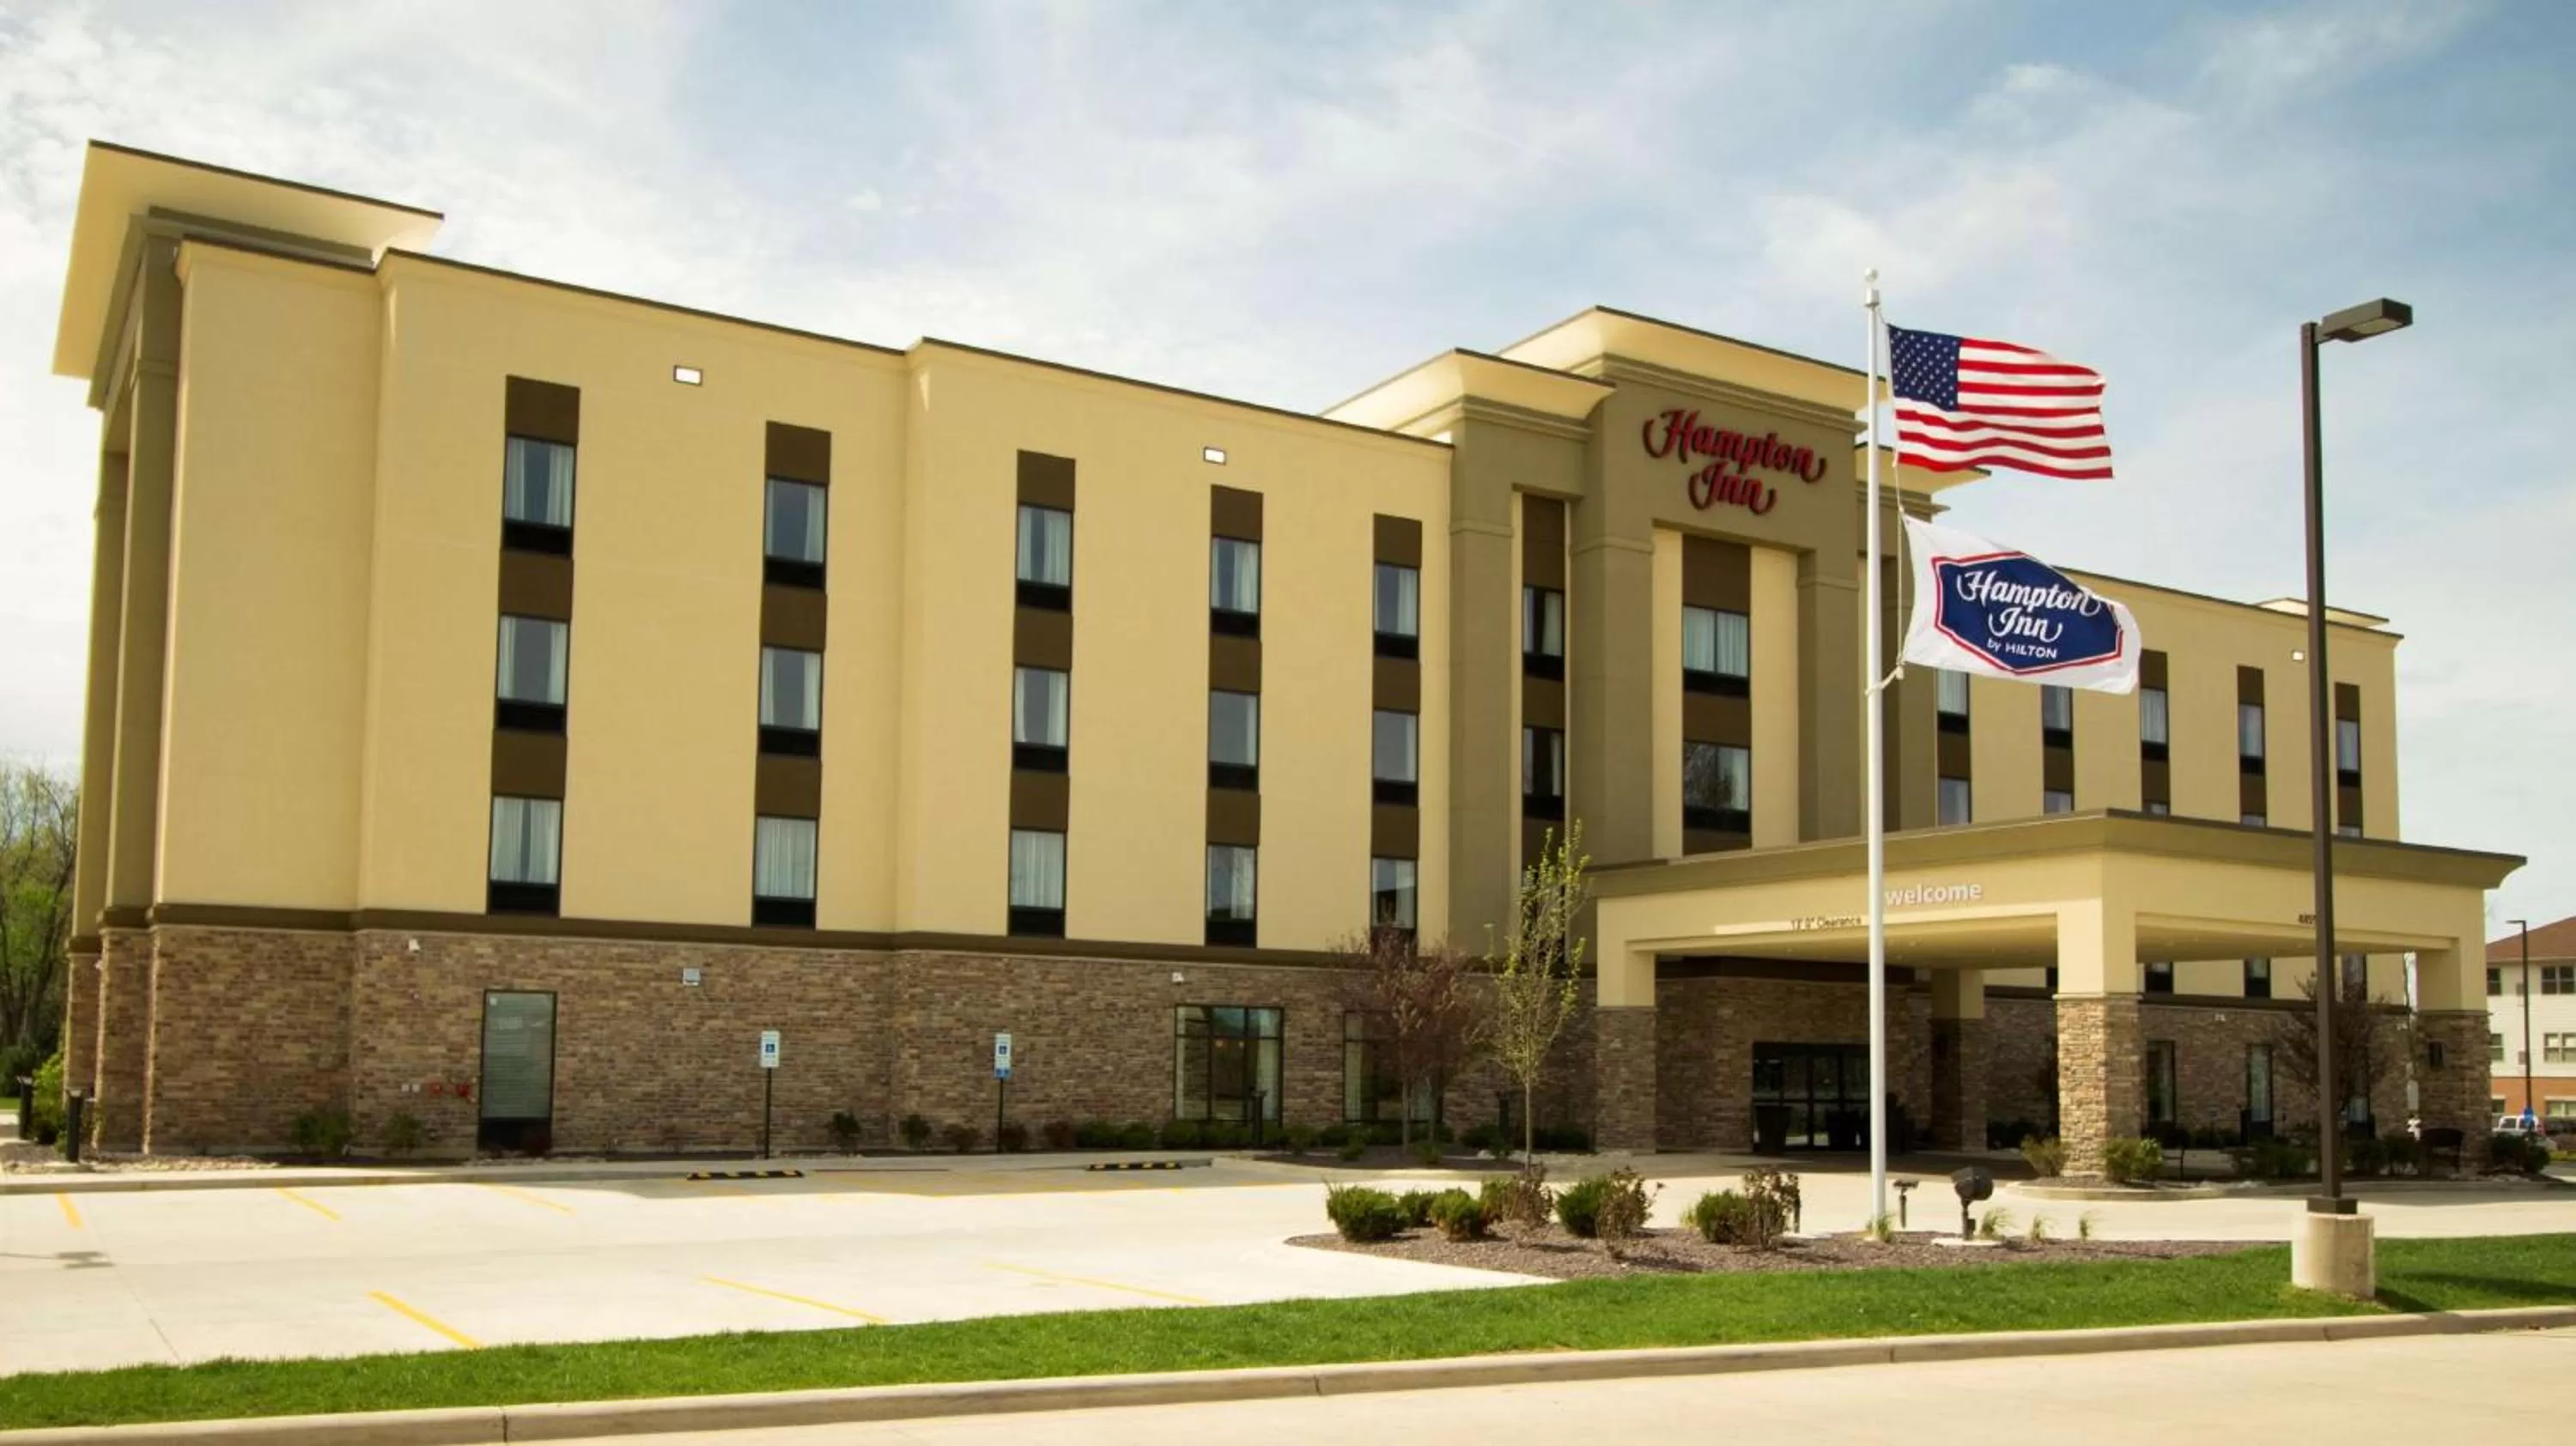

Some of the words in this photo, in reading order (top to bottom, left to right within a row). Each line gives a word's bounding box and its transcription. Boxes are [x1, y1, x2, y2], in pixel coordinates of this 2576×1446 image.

[1643, 410, 1827, 483] Hampton
[1687, 460, 1777, 515] Inn
[1956, 570, 2101, 617] Hampton
[1988, 604, 2063, 643] Inn
[1987, 636, 2002, 653] by
[2005, 641, 2058, 660] HILTON
[1885, 883, 1983, 907] welcome
